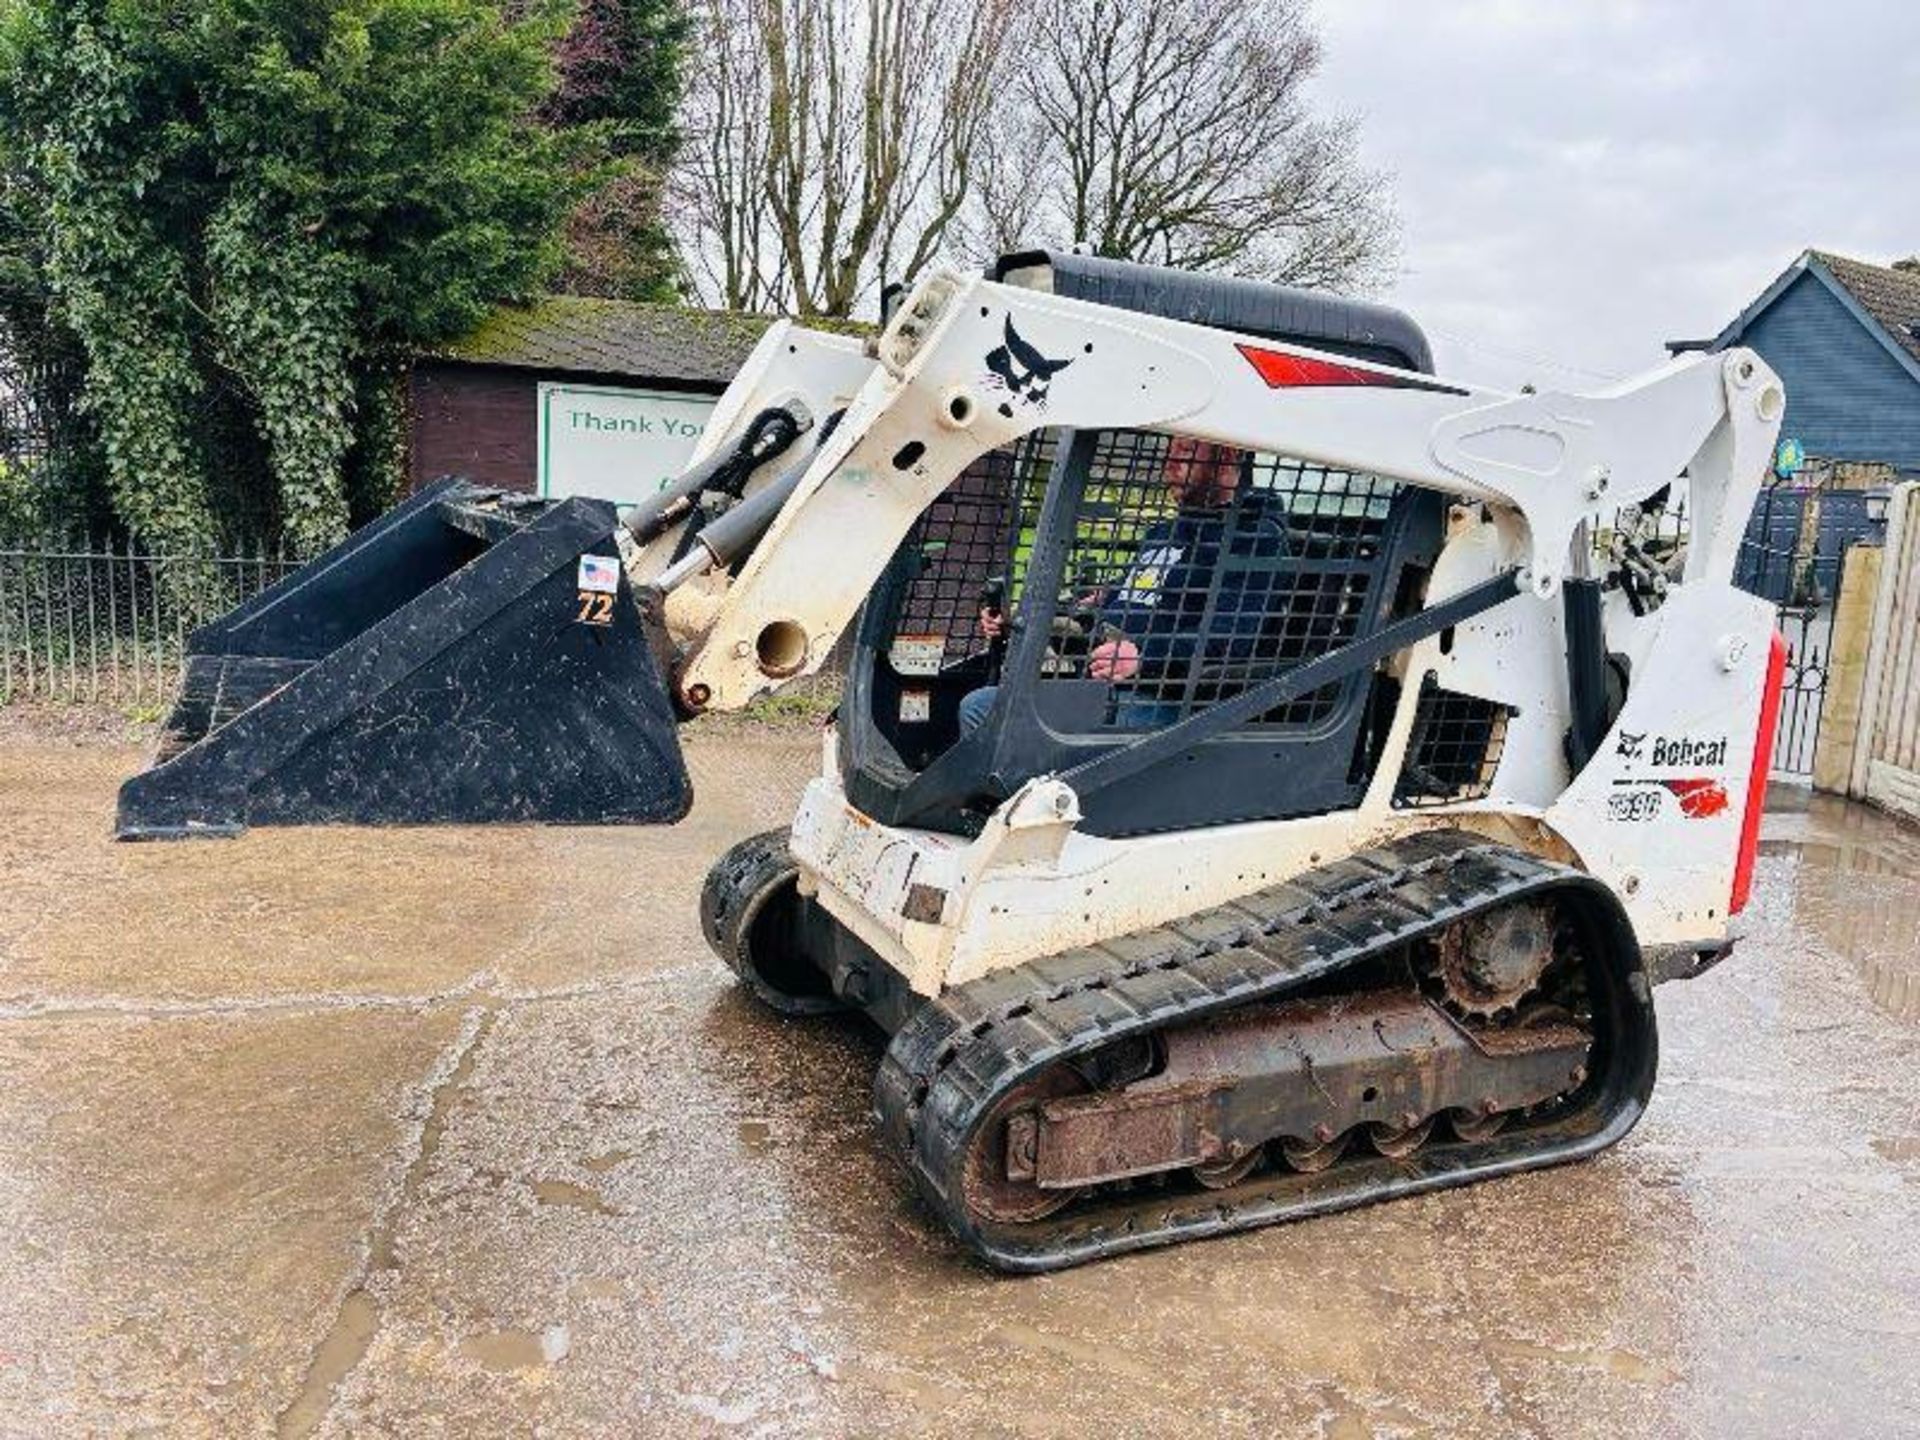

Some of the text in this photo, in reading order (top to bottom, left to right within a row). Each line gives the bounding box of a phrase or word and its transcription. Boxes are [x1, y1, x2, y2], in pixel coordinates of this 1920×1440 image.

[568, 411, 652, 433] Thank
[577, 592, 614, 622] 72
[1651, 736, 1727, 766] Bobcat
